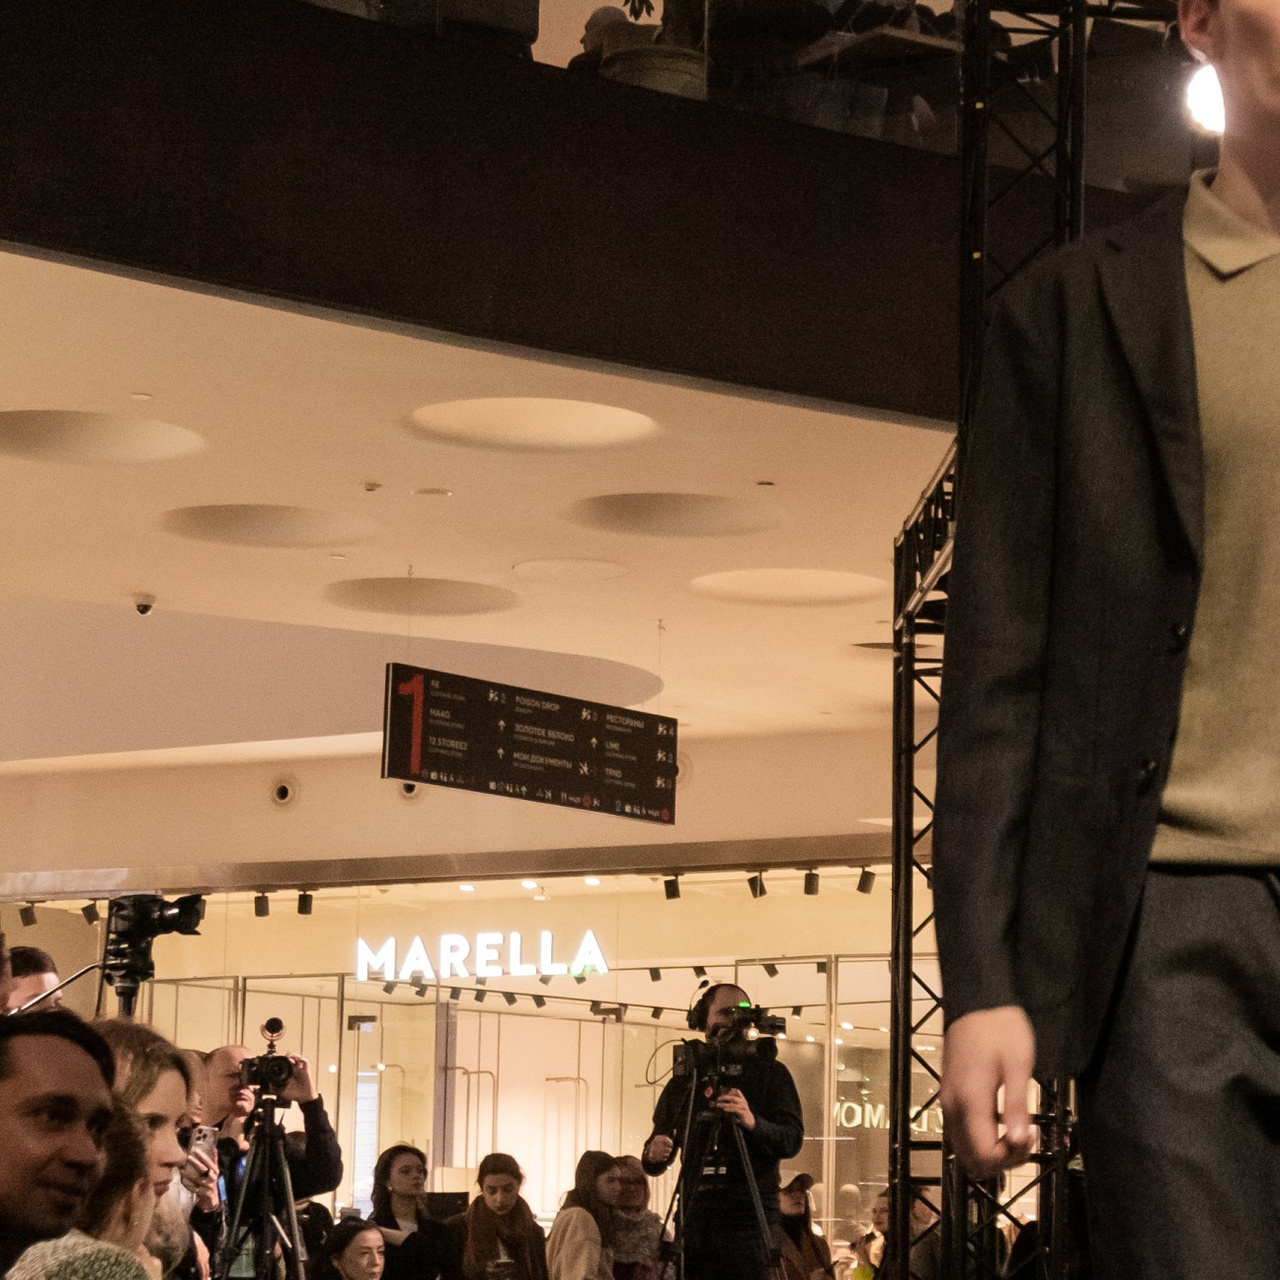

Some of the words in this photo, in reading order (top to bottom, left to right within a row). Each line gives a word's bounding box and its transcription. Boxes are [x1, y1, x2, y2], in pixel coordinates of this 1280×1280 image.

[398, 674, 425, 776] 1
[605, 714, 645, 729] РЕСТОРАНЫ
[357, 929, 609, 981] MARELLA
